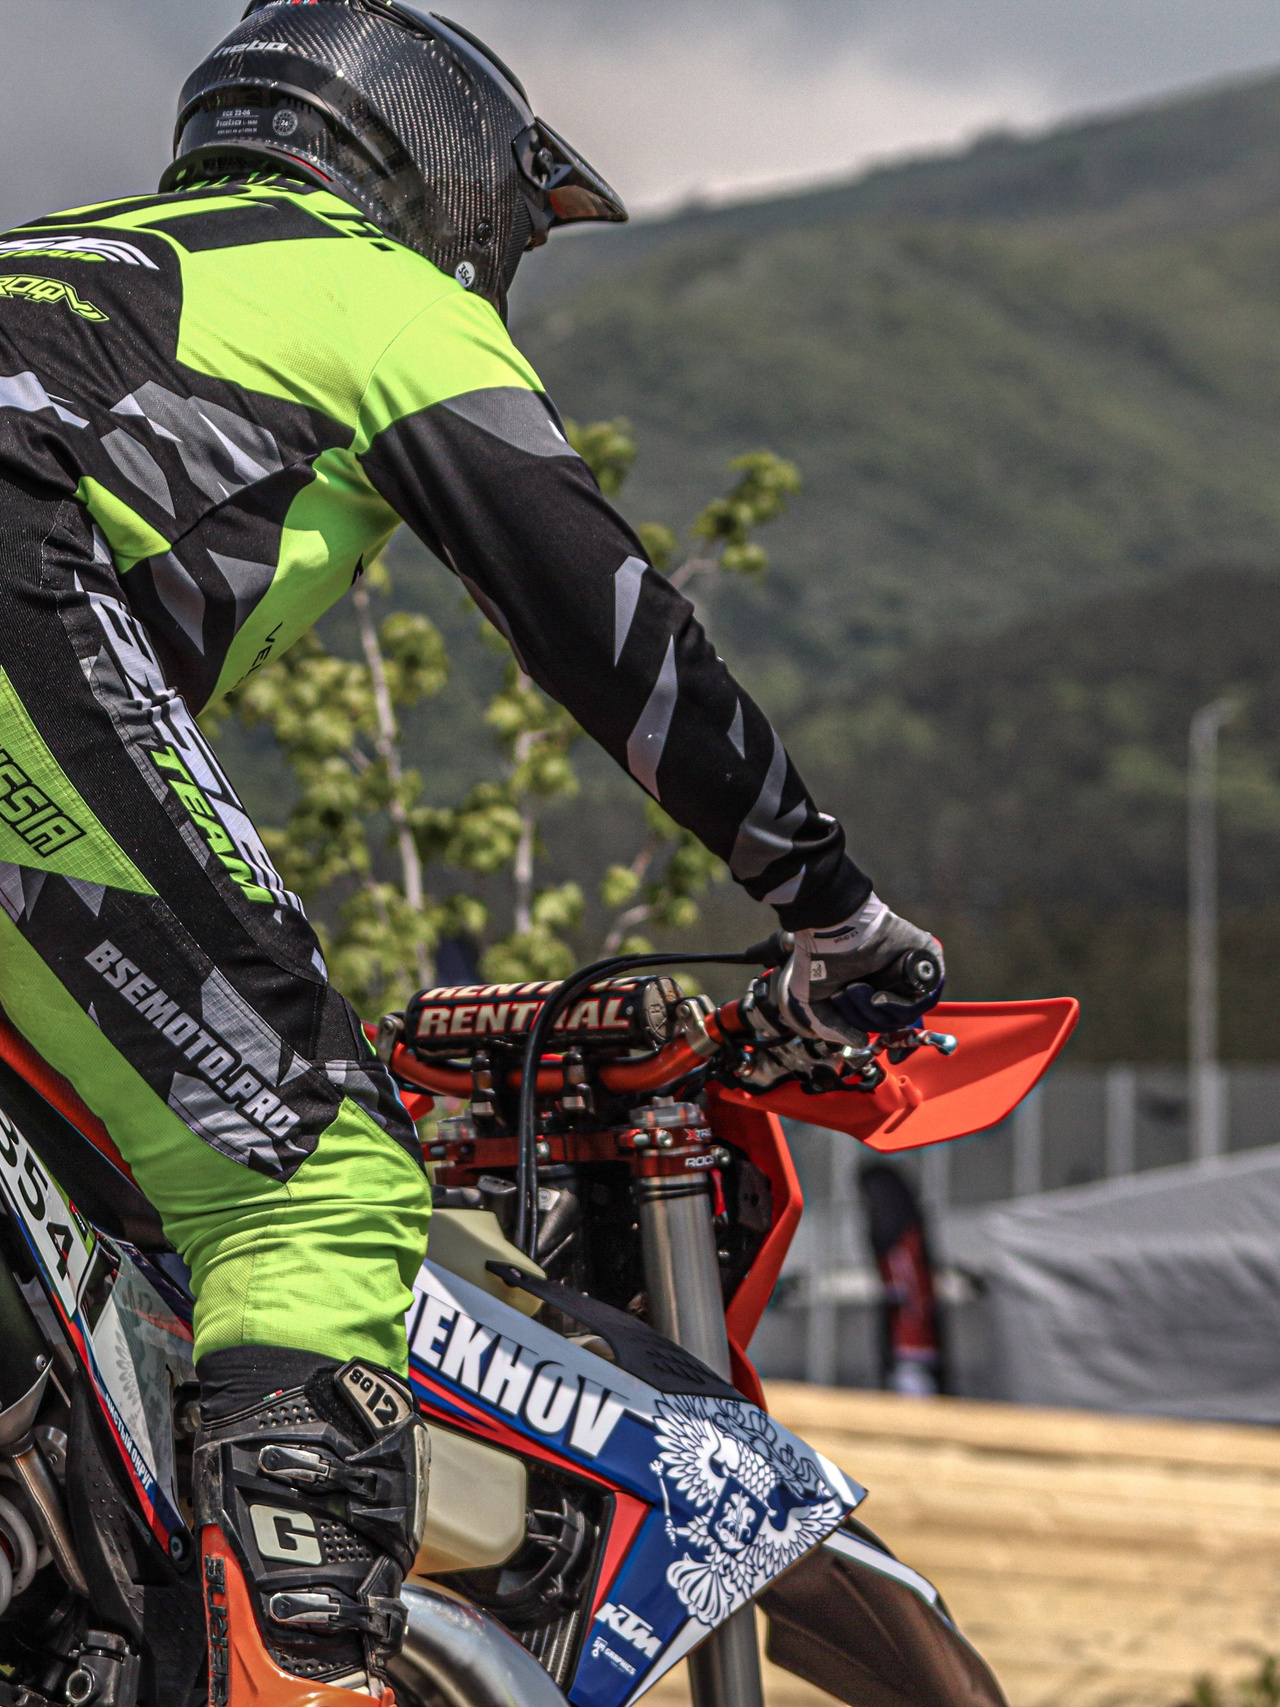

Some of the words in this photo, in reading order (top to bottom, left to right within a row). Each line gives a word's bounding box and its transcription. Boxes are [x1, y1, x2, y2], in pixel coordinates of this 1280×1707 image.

[457, 263, 473, 286] 354
[150, 745, 274, 904] TEAM
[84, 939, 300, 1139] BSEMOTO.PRO
[594, 1601, 663, 1659] KTM
